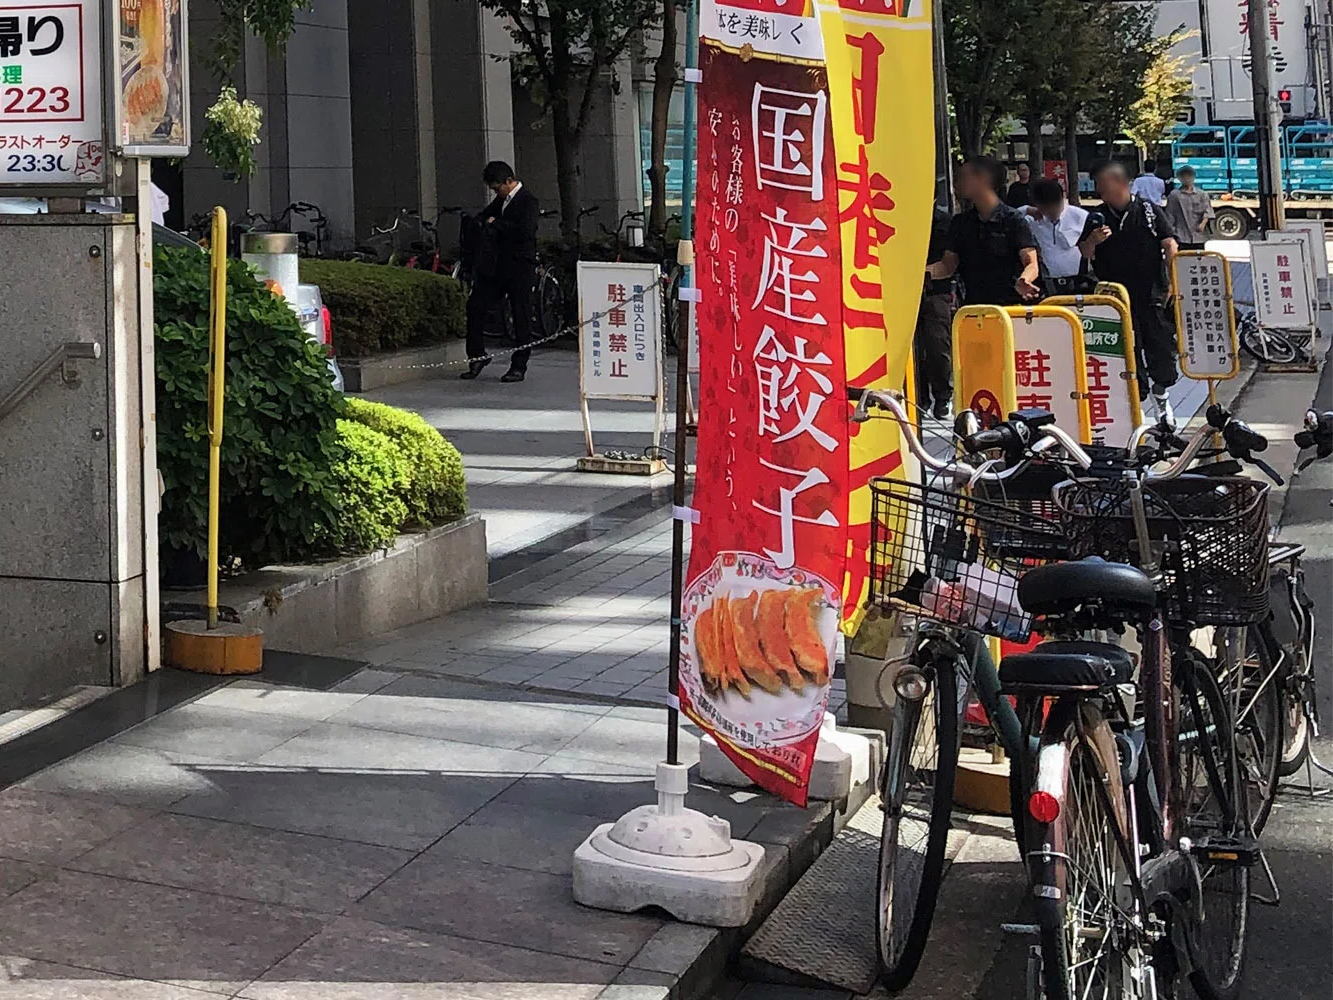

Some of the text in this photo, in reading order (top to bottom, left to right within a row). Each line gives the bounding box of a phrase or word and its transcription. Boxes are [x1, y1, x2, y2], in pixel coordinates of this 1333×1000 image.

[7, 154, 71, 172] 23:30
[1276, 255, 1296, 315] 駐車禁止
[607, 283, 629, 379] 駐車禁止
[751, 81, 839, 569] 国産餃子
